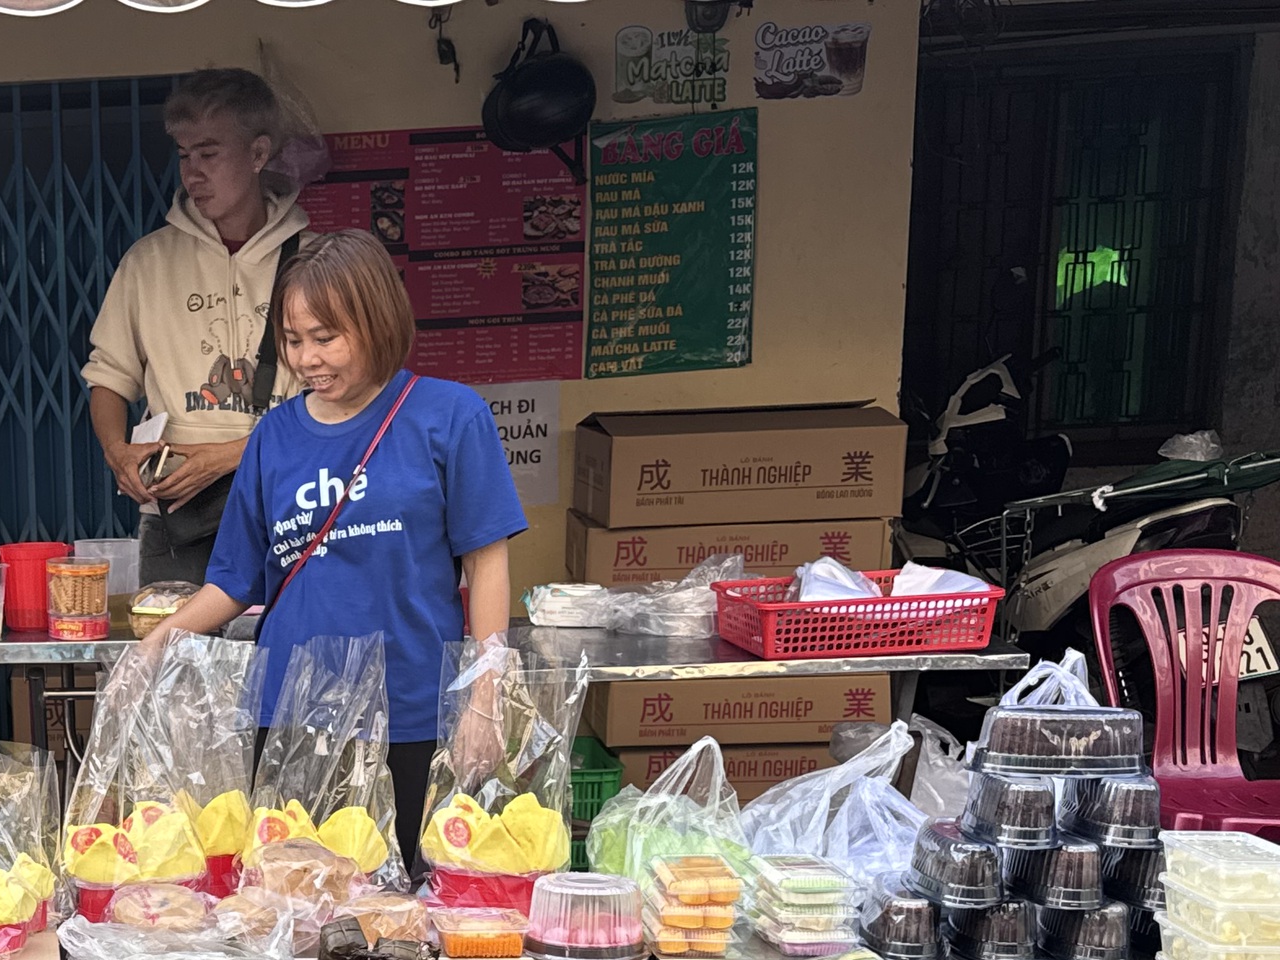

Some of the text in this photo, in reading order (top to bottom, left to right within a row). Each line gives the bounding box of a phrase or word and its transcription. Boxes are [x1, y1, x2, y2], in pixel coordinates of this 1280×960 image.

[755, 22, 828, 50] Cacao
[671, 78, 726, 104] LATTE
[334, 133, 390, 150] MENU
[601, 116, 746, 165] BẢNG GIÁ
[732, 162, 754, 174] 12K
[731, 179, 754, 191] 12K
[595, 188, 641, 202] RAU MÁ
[730, 197, 754, 209] 15K
[595, 208, 618, 220] RAU
[622, 206, 640, 218] MÁ
[672, 201, 705, 214] XANH
[730, 215, 753, 226] 15K
[595, 225, 617, 237] RAU
[622, 223, 640, 235] MÁ
[594, 241, 616, 254] TRÀ
[729, 250, 751, 261] 12K
[594, 258, 616, 271] TRÀ
[728, 267, 751, 278] 12K
[594, 277, 634, 288] CHANH
[728, 284, 751, 296] 14K
[593, 292, 609, 306] CÀ
[593, 309, 608, 322] CÀ
[592, 326, 608, 339] CÀ
[591, 339, 677, 357] MATCHA LATTE
[517, 399, 535, 414] ĐI
[497, 418, 548, 442] QUẢN
[841, 451, 874, 482] 業
[637, 459, 671, 491] 成
[348, 524, 376, 538] không
[377, 519, 402, 533] thích
[614, 536, 647, 567] 成
[640, 692, 673, 723] 成
[842, 688, 876, 718] 業
